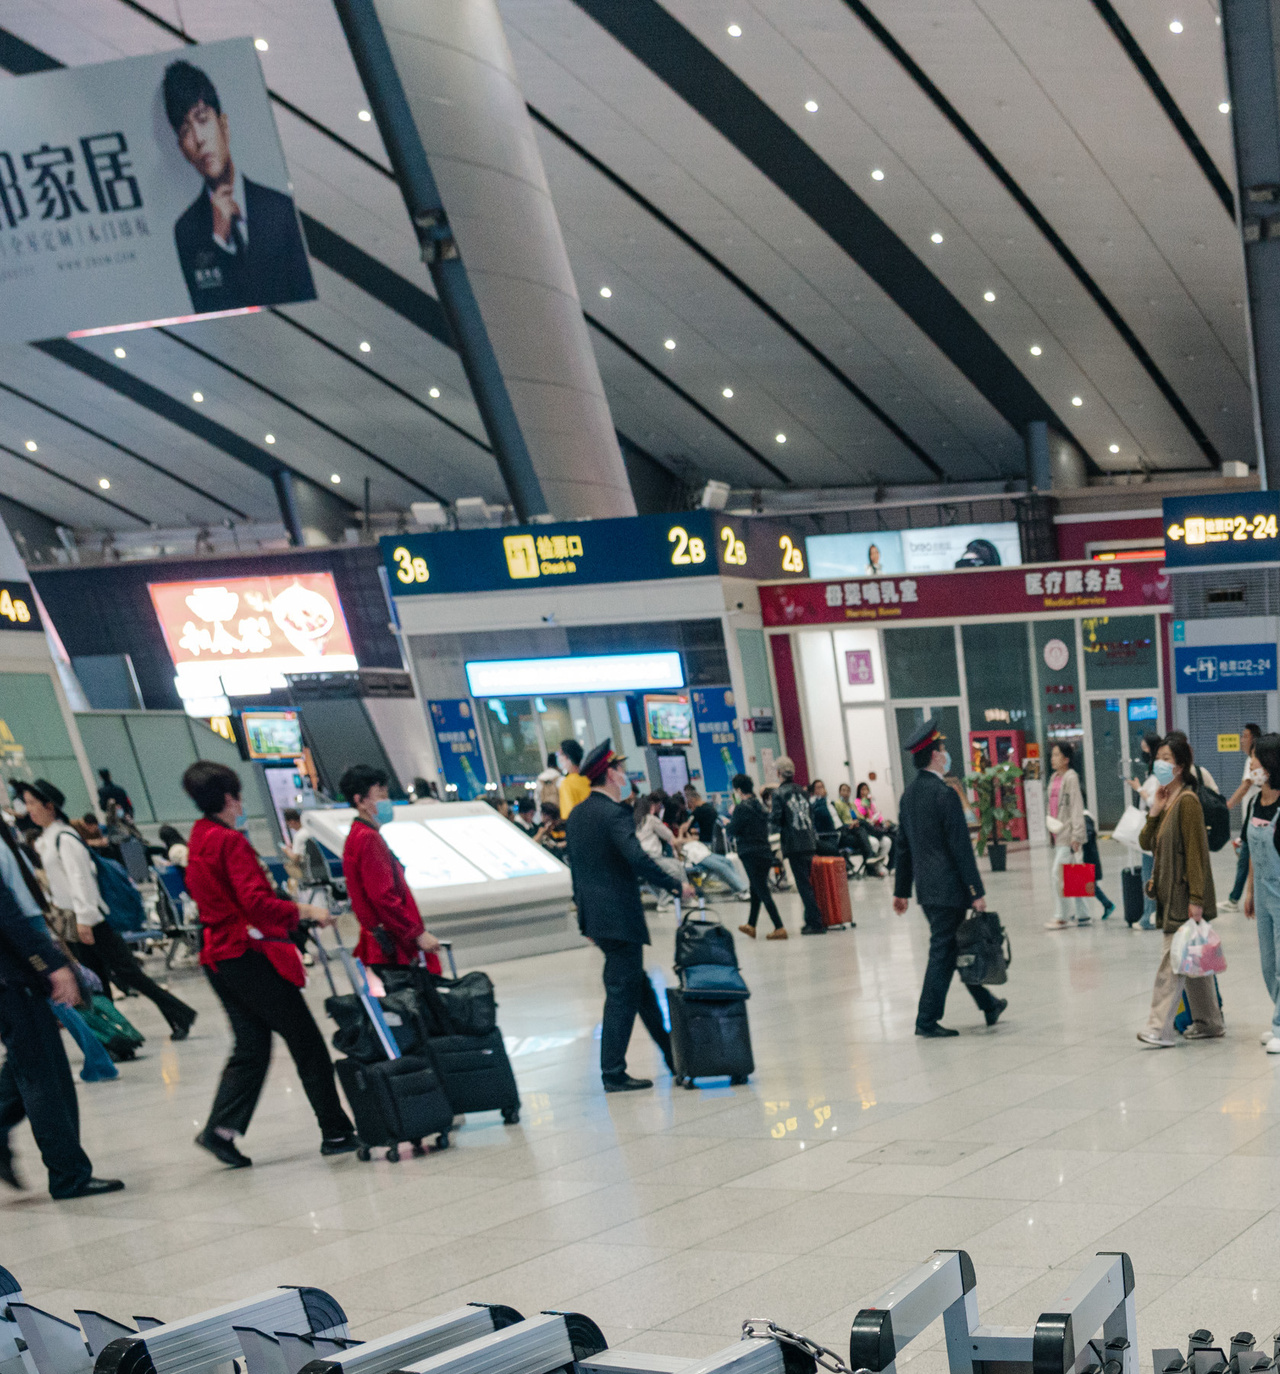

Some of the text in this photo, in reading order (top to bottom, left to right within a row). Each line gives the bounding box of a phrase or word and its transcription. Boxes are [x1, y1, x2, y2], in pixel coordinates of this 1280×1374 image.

[1233, 514, 1279, 540] 2-24
[536, 534, 583, 560] 检票口
[667, 526, 706, 566] 2B
[720, 526, 747, 566] 2B
[778, 535, 804, 573] 2B
[393, 547, 430, 584] 3B
[1024, 567, 1124, 596] 医疗服务点
[0, 589, 31, 622] 4B
[825, 579, 919, 607] 母婴哺乳室
